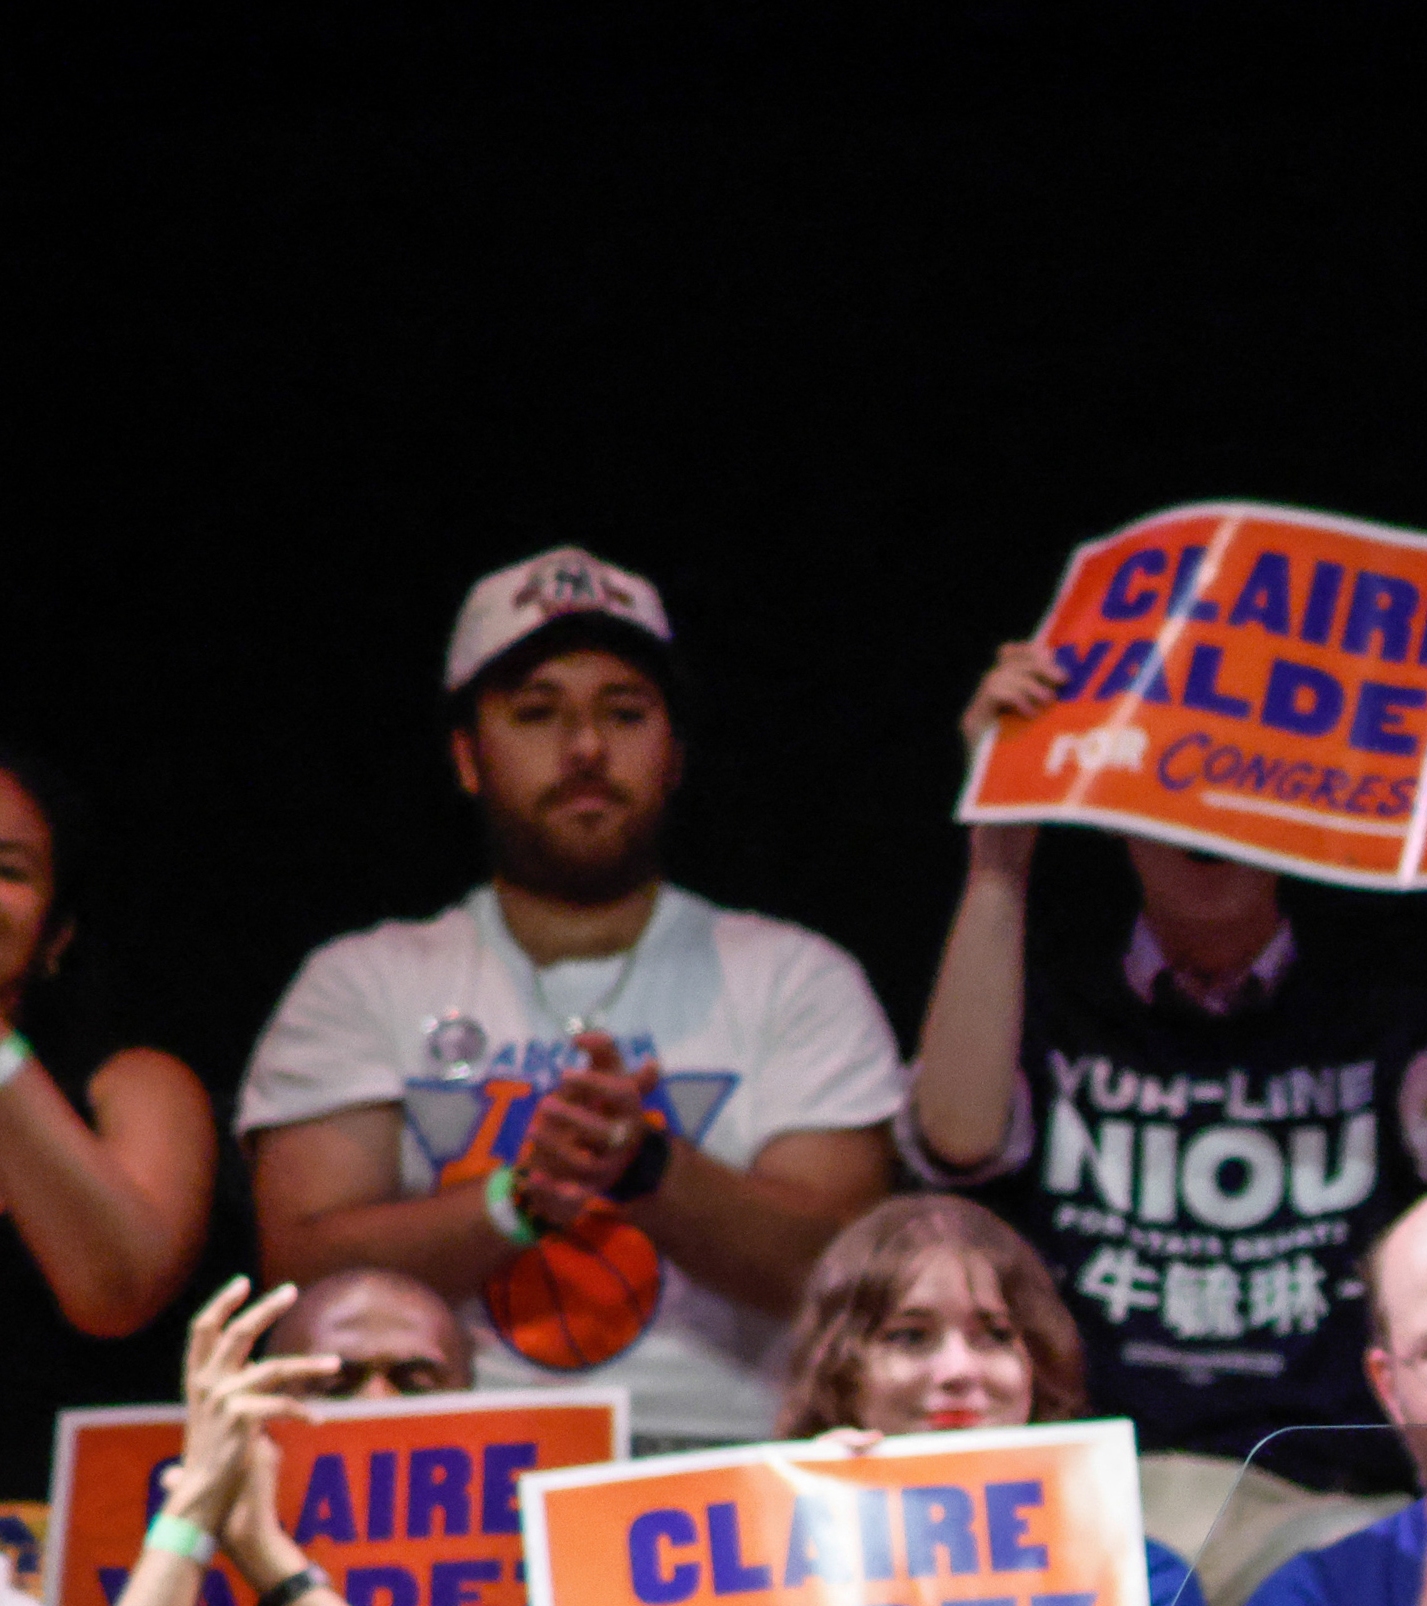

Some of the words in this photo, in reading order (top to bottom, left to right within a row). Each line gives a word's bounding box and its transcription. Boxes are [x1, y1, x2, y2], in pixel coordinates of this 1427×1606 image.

[1043, 1100, 1378, 1231] NIOU
[146, 1443, 537, 1546] AIRE
[628, 1480, 1049, 1606] CLAIRE
